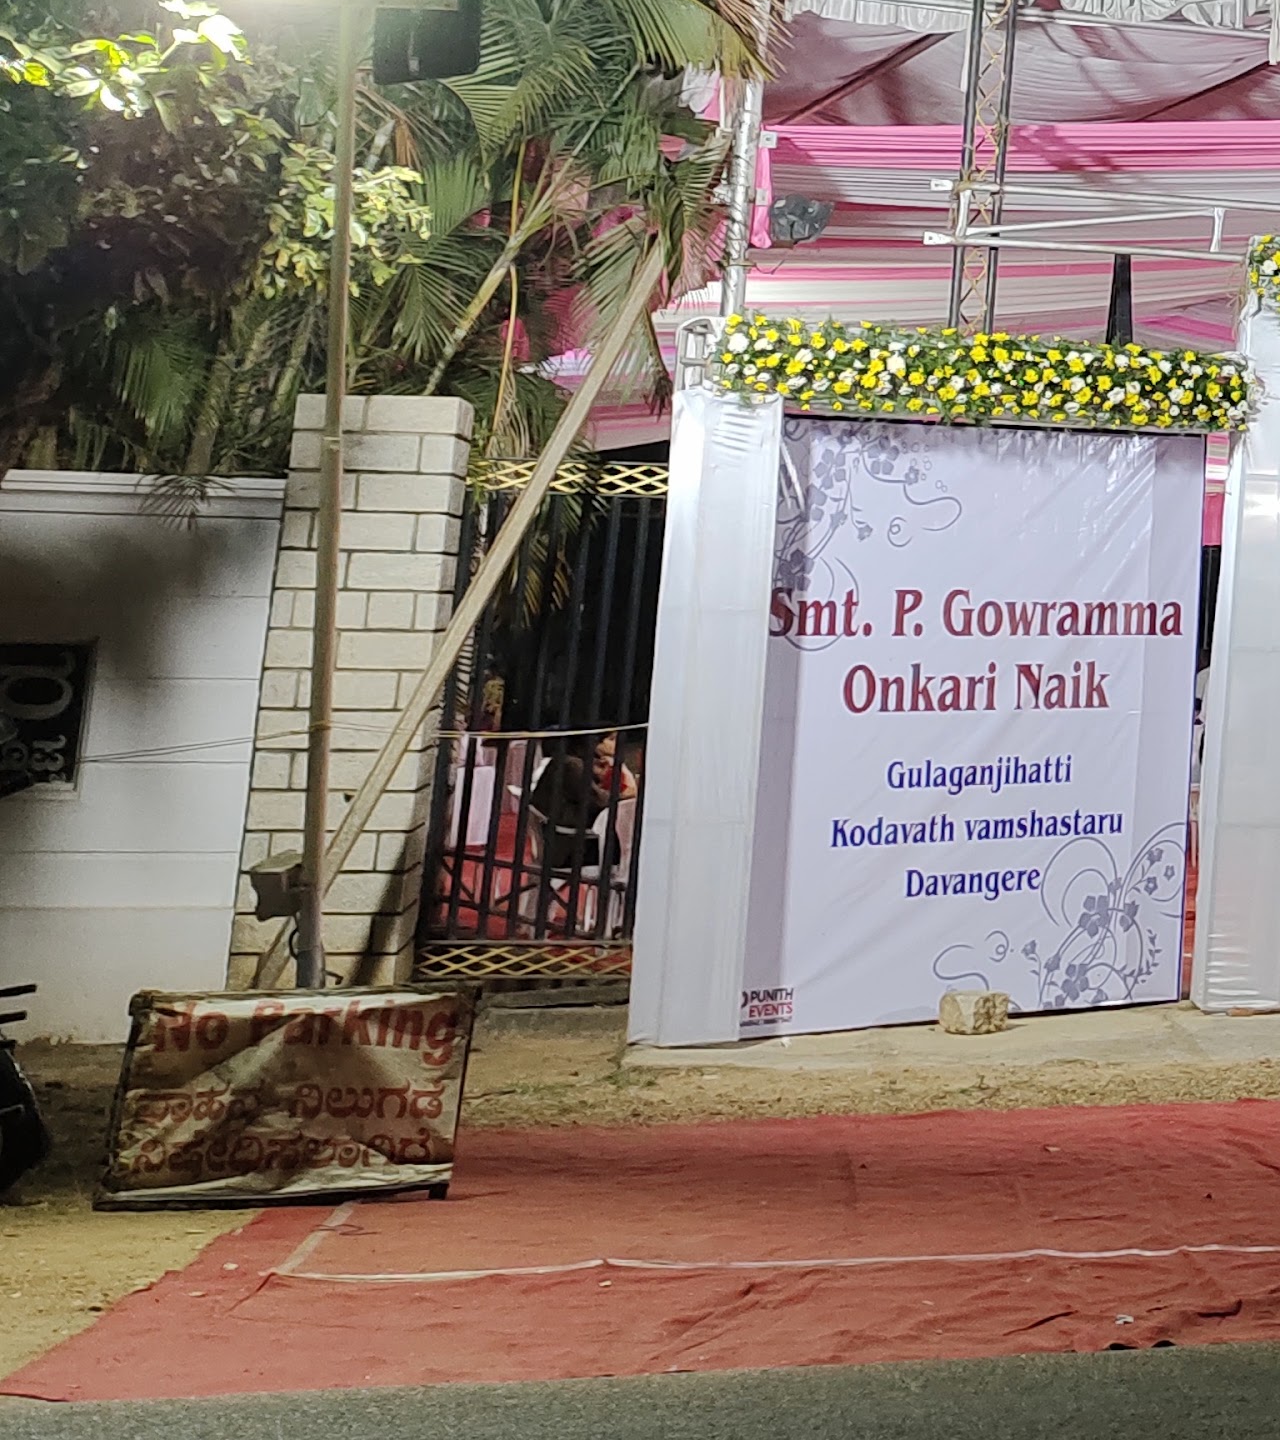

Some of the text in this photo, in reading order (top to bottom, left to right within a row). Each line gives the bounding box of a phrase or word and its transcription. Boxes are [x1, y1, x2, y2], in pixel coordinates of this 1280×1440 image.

[769, 587, 1183, 637] Smt. P. Gowramma
[843, 660, 1110, 713] Onkari Naik
[887, 755, 1072, 795] Gulaganjihatti
[830, 809, 1123, 847] Kodavath vamshastaru
[905, 868, 1041, 900] Davangere
[749, 1002, 793, 1017] EVENTS
[750, 988, 794, 1002] PUNITH
[153, 999, 456, 1066] No Parking
